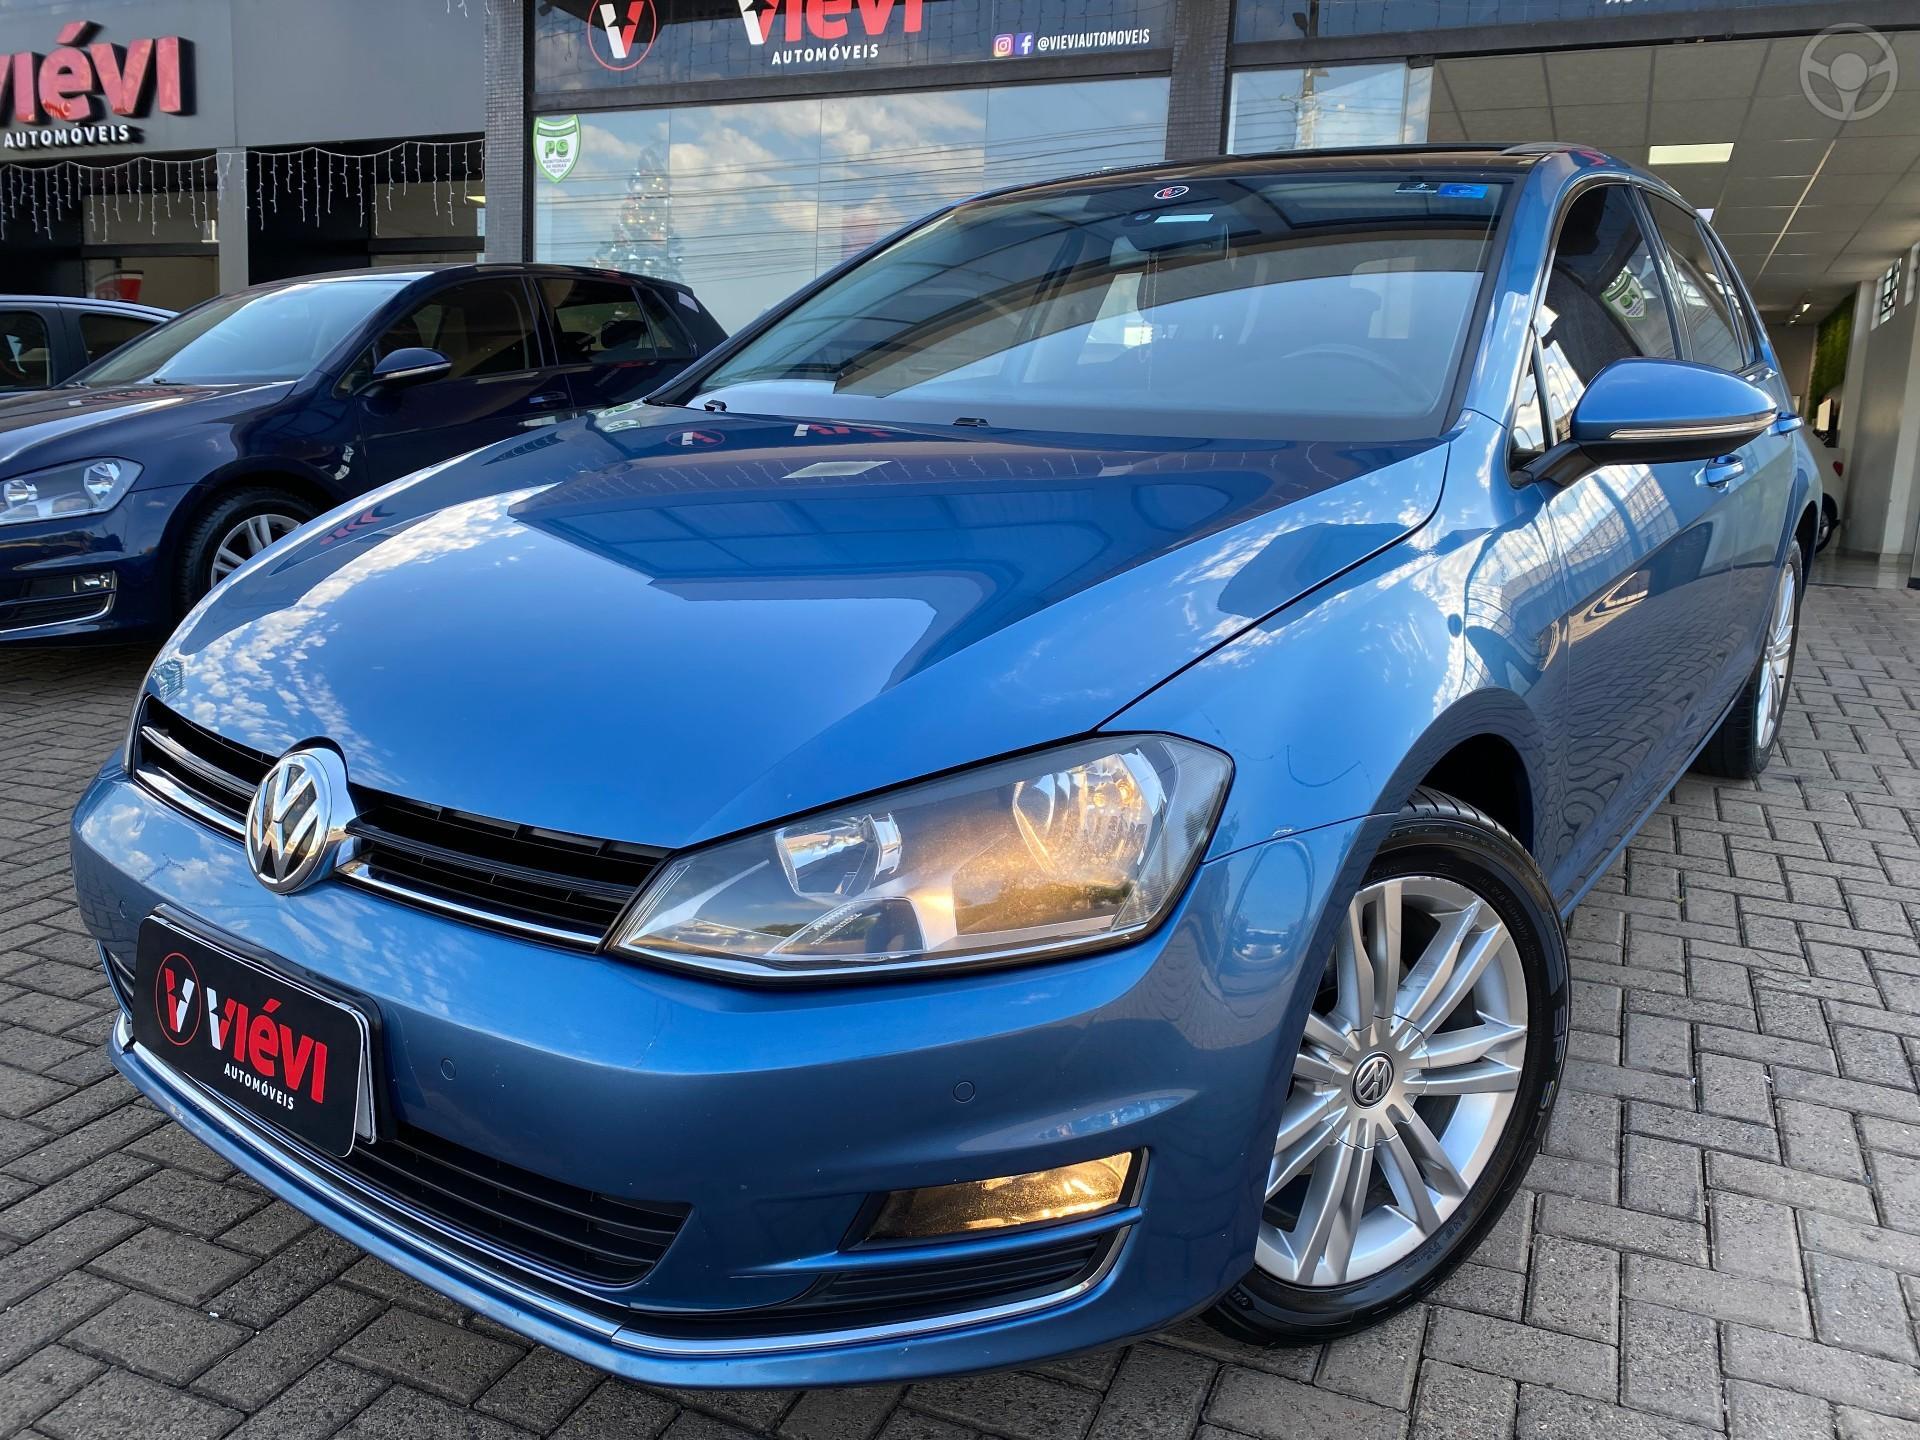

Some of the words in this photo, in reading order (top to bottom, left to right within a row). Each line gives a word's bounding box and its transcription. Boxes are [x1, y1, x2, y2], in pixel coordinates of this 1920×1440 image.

[1037, 28, 1150, 51] @VIEVIAUTOMOVEIS
[771, 44, 879, 65] AUTOMÓVEIS
[3, 123, 130, 148] AUTOMÓVEIS
[223, 1062, 295, 1111] AUTOMÓVEIS
